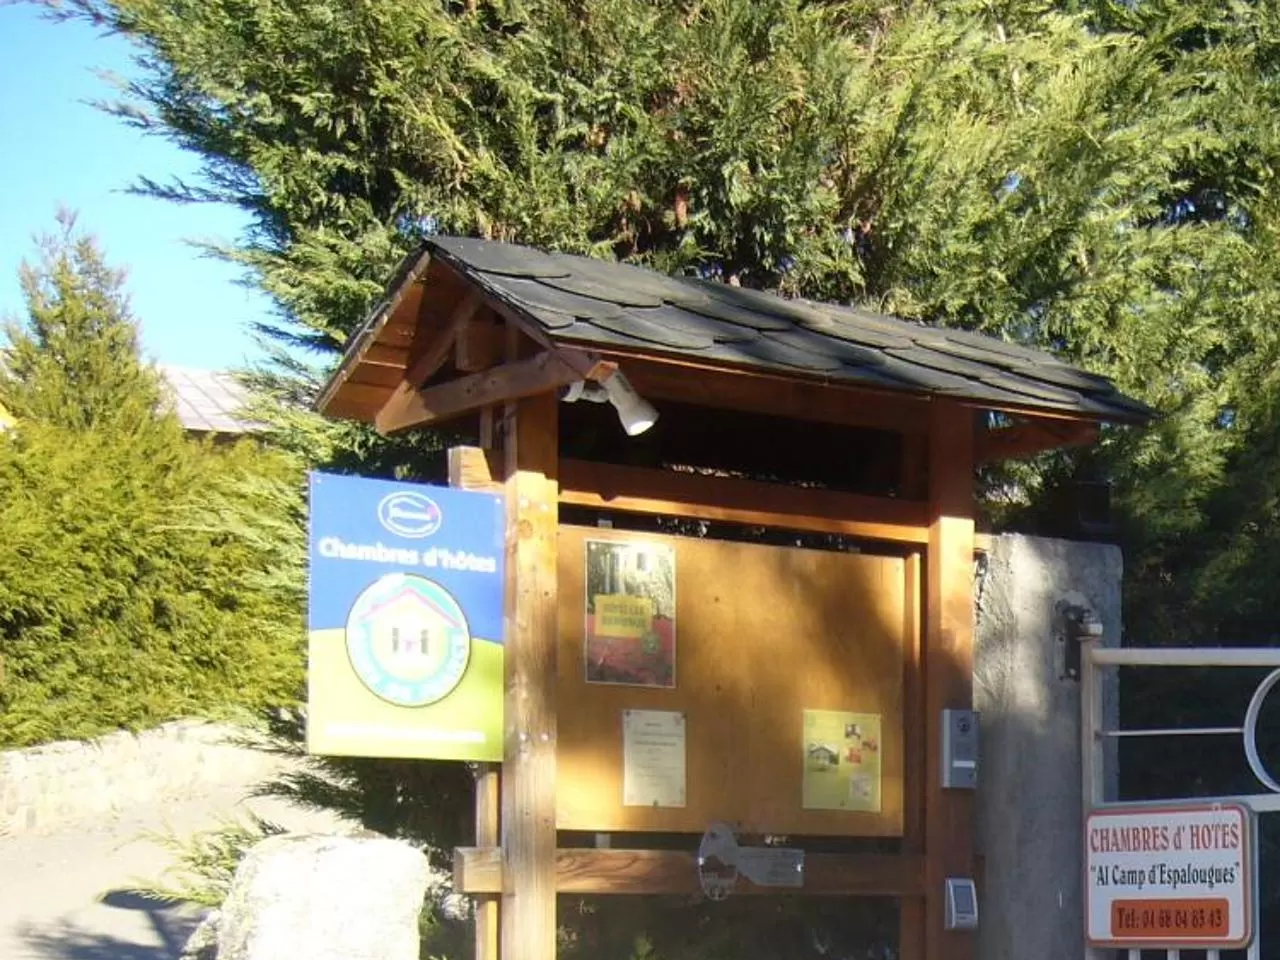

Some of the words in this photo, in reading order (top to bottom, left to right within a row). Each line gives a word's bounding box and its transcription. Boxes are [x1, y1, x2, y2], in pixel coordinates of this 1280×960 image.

[319, 536, 419, 565] Chambres
[1090, 826, 1169, 852] CHAMBRES
[1174, 825, 1186, 851] d'
[1190, 823, 1240, 850] HOTES
[1112, 864, 1146, 889] Camp
[1175, 908, 1189, 929] 04
